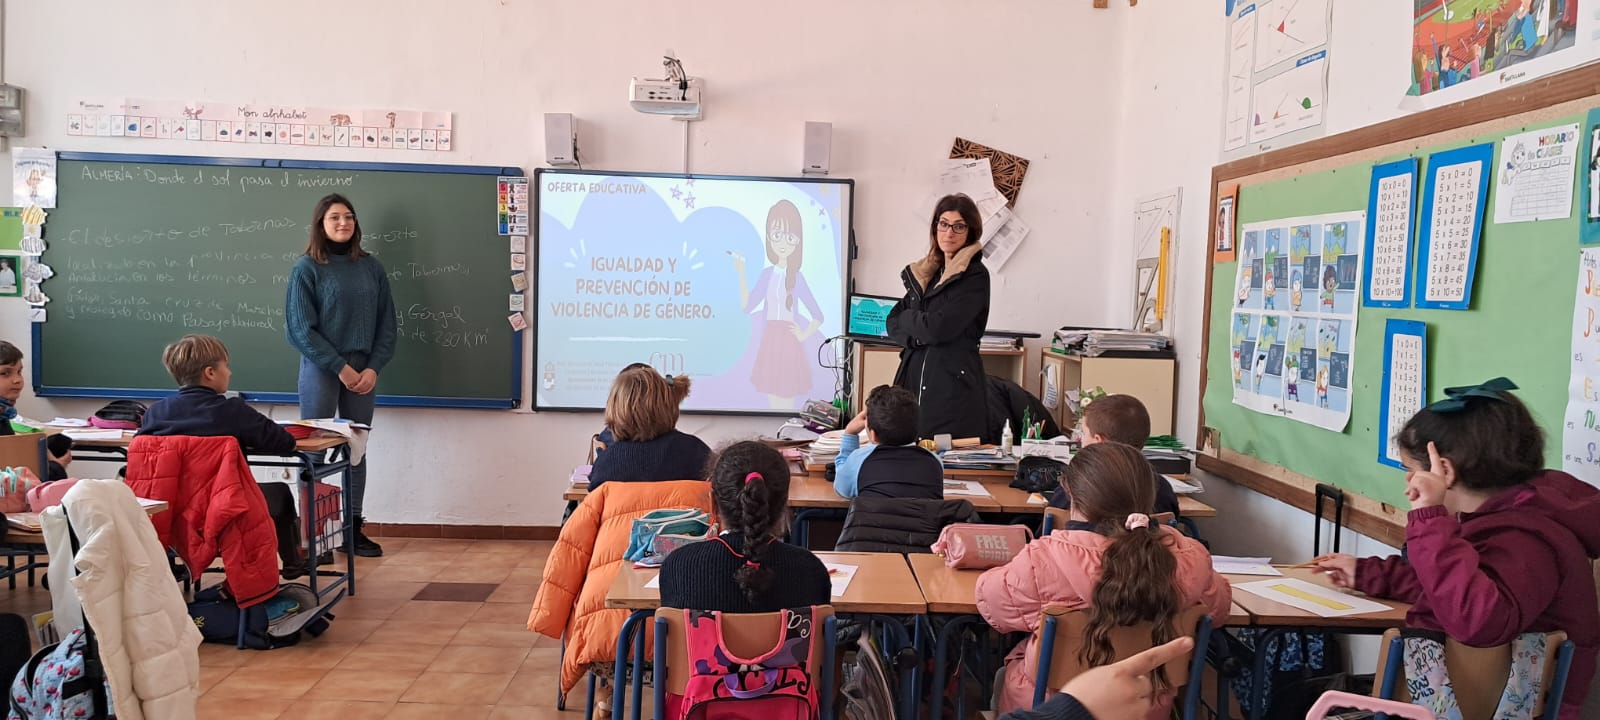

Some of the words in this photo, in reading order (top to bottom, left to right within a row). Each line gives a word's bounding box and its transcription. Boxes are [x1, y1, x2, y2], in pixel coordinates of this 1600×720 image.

[238, 107, 259, 119] Mon
[263, 107, 307, 123] alphabet
[211, 168, 231, 186] sol
[240, 175, 273, 193] pasa
[547, 182, 586, 193] OFERTA
[589, 183, 647, 195] EDUCATIVA
[591, 256, 664, 273] IGUALDAD
[666, 257, 677, 273] Y
[576, 275, 670, 296] PREVENCIÓN
[673, 280, 691, 297] DE
[551, 301, 629, 319] VIOLENCIA
[633, 303, 651, 318] DE
[655, 299, 716, 319] GÉNERO.
[976, 535, 1009, 549] FREE
[978, 550, 1012, 561] SPIRIT
